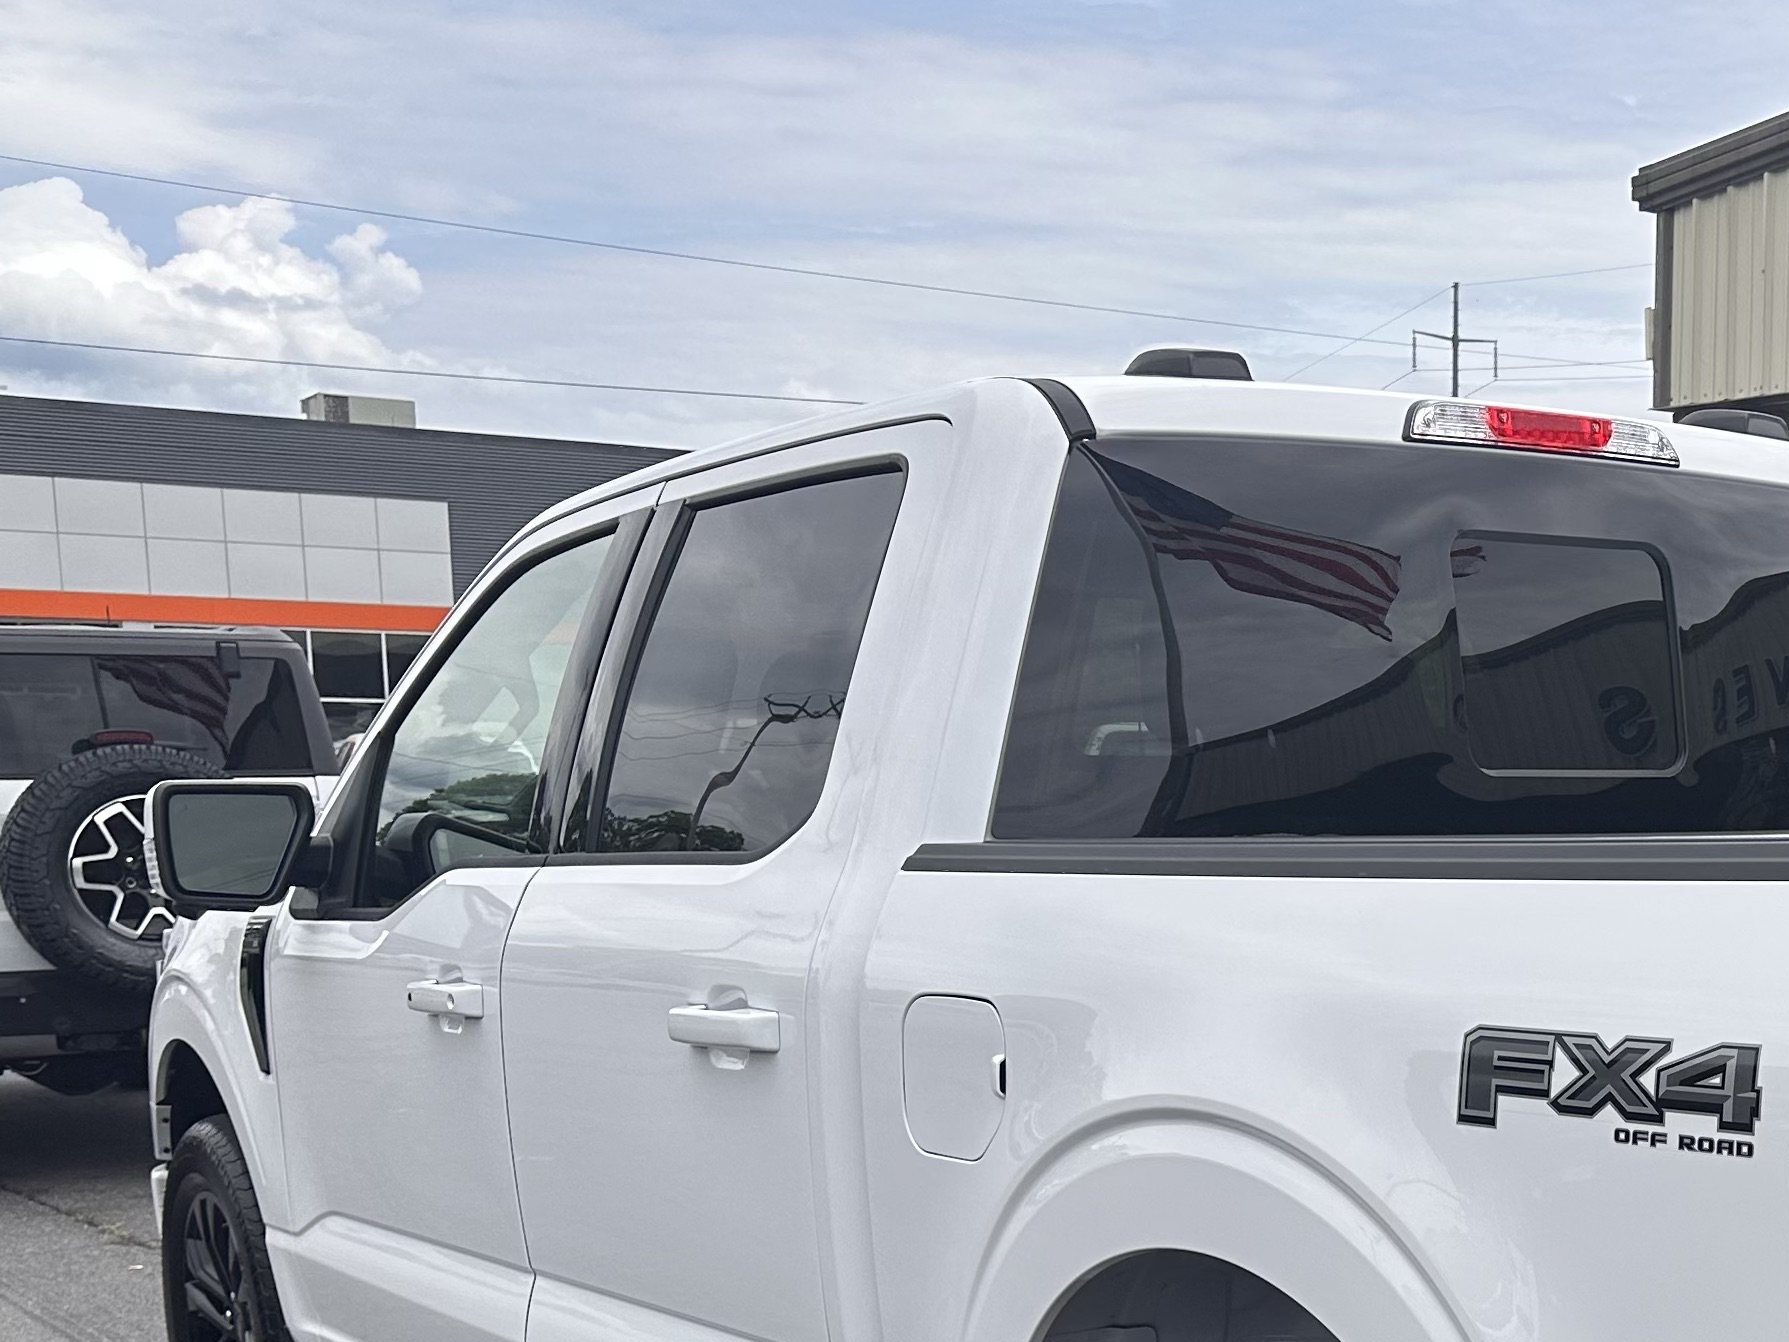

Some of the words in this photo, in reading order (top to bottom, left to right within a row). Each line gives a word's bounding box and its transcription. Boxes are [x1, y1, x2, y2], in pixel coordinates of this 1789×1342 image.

[1456, 1024, 1763, 1135] FX4
[1613, 1127, 1668, 1148] OFF
[1678, 1133, 1755, 1159] ROAD
